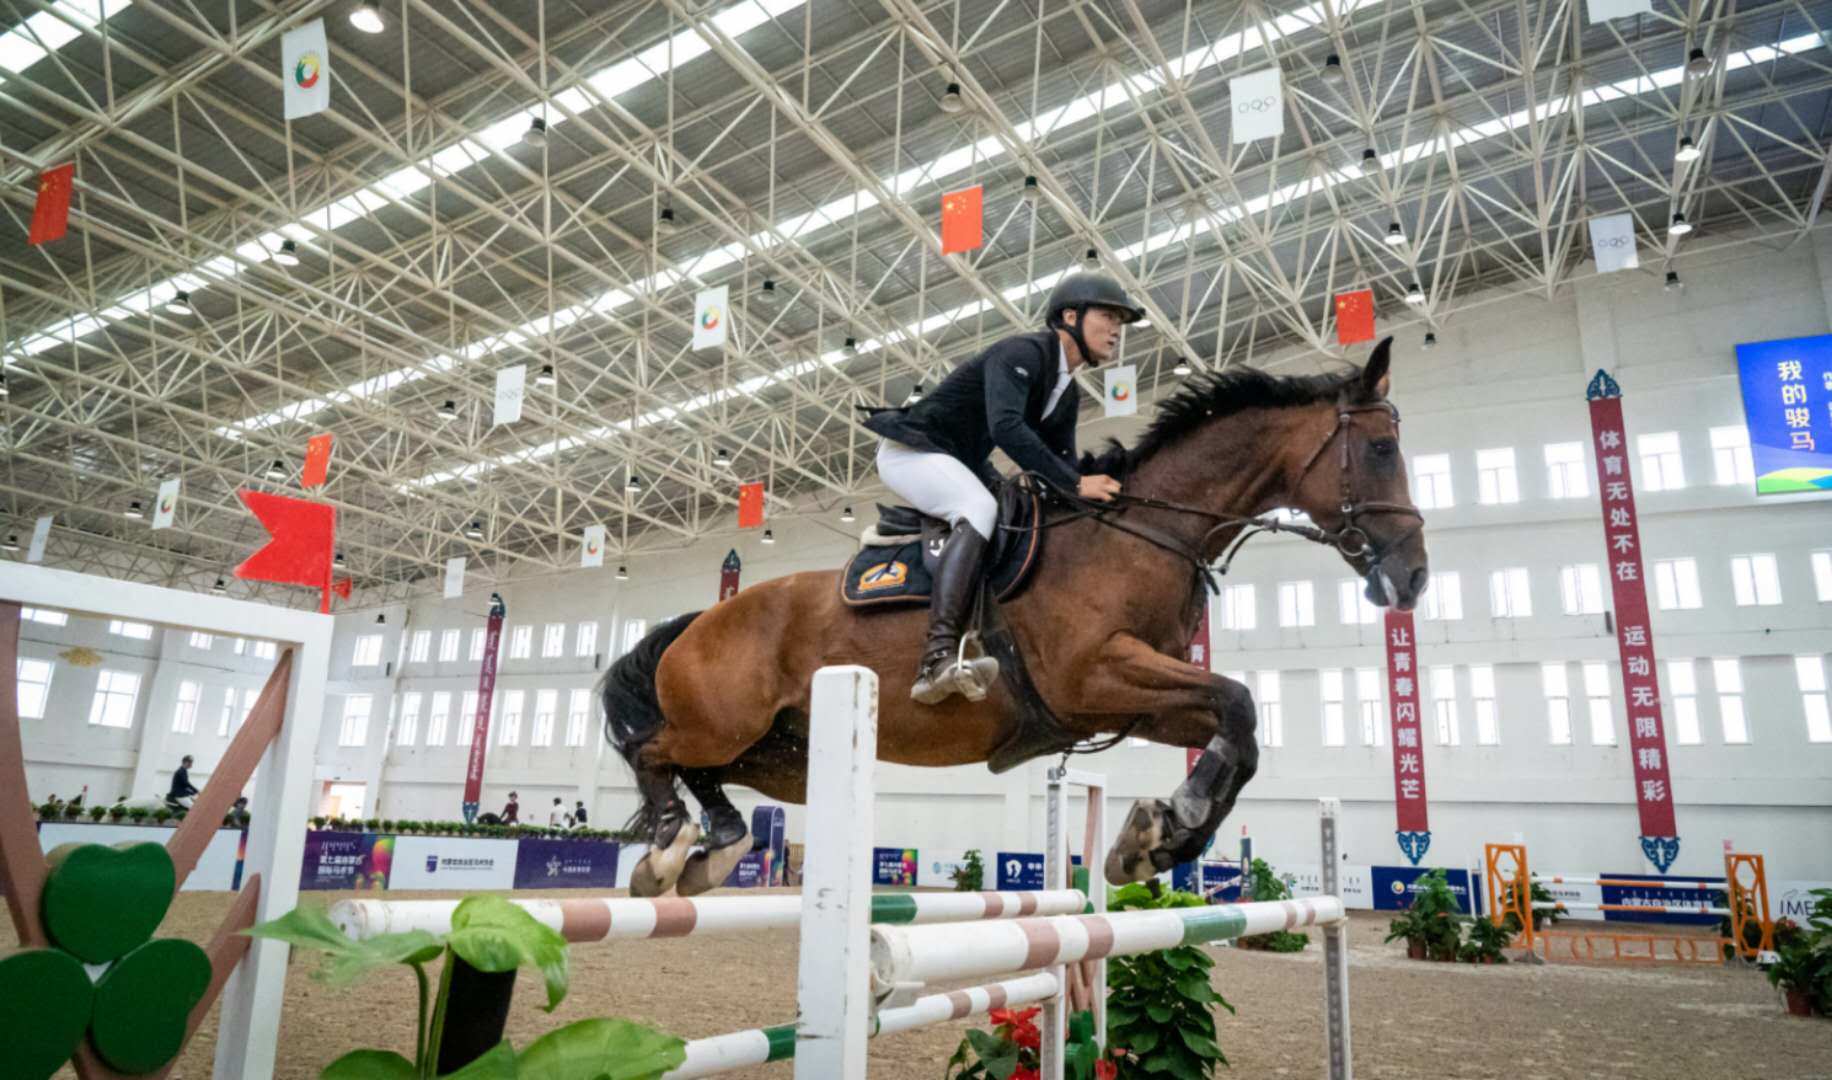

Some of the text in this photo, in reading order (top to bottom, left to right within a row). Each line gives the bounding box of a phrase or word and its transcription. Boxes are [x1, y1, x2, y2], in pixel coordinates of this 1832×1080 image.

[1777, 360, 1815, 451] 我的骏马
[1600, 430, 1666, 801] 体育无处不在 运动无限精彩
[1391, 628, 1420, 799] 让青春闪耀光芒
